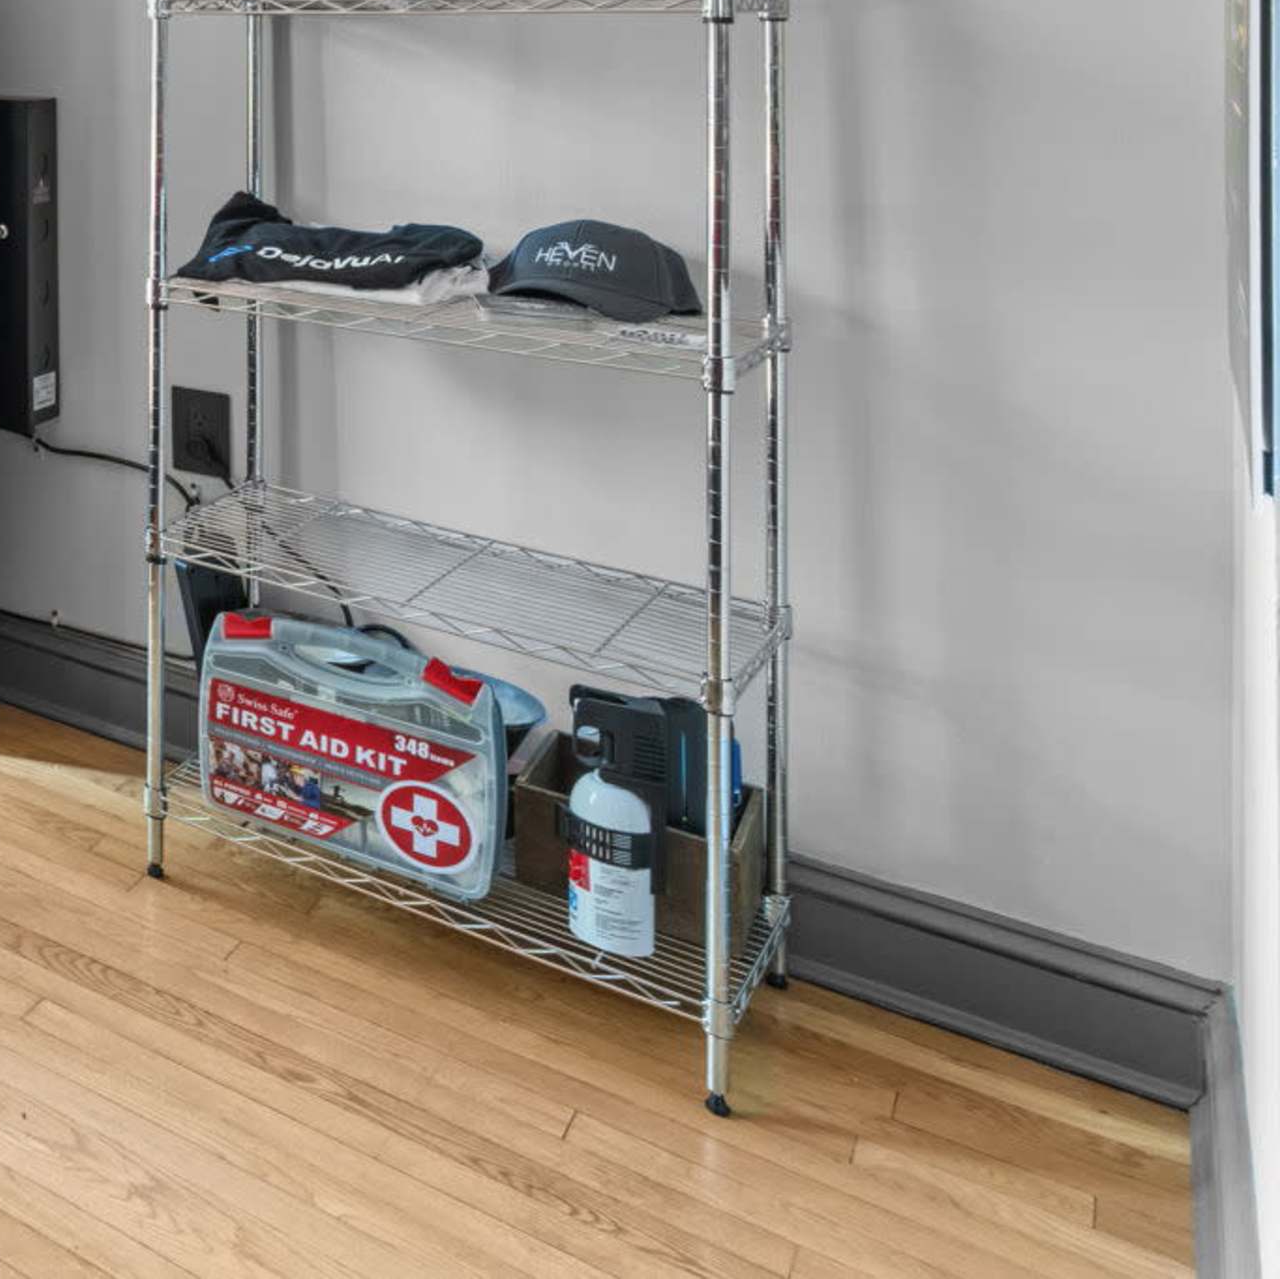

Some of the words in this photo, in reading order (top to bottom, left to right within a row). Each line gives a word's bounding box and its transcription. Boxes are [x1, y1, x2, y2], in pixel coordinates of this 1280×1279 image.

[535, 241, 617, 271] HEVEN
[237, 692, 269, 712] Swiss
[269, 703, 295, 720] Safe
[215, 702, 295, 741] FIRST
[299, 730, 350, 759] AID
[355, 745, 407, 776] KIT
[394, 734, 430, 760] 348
